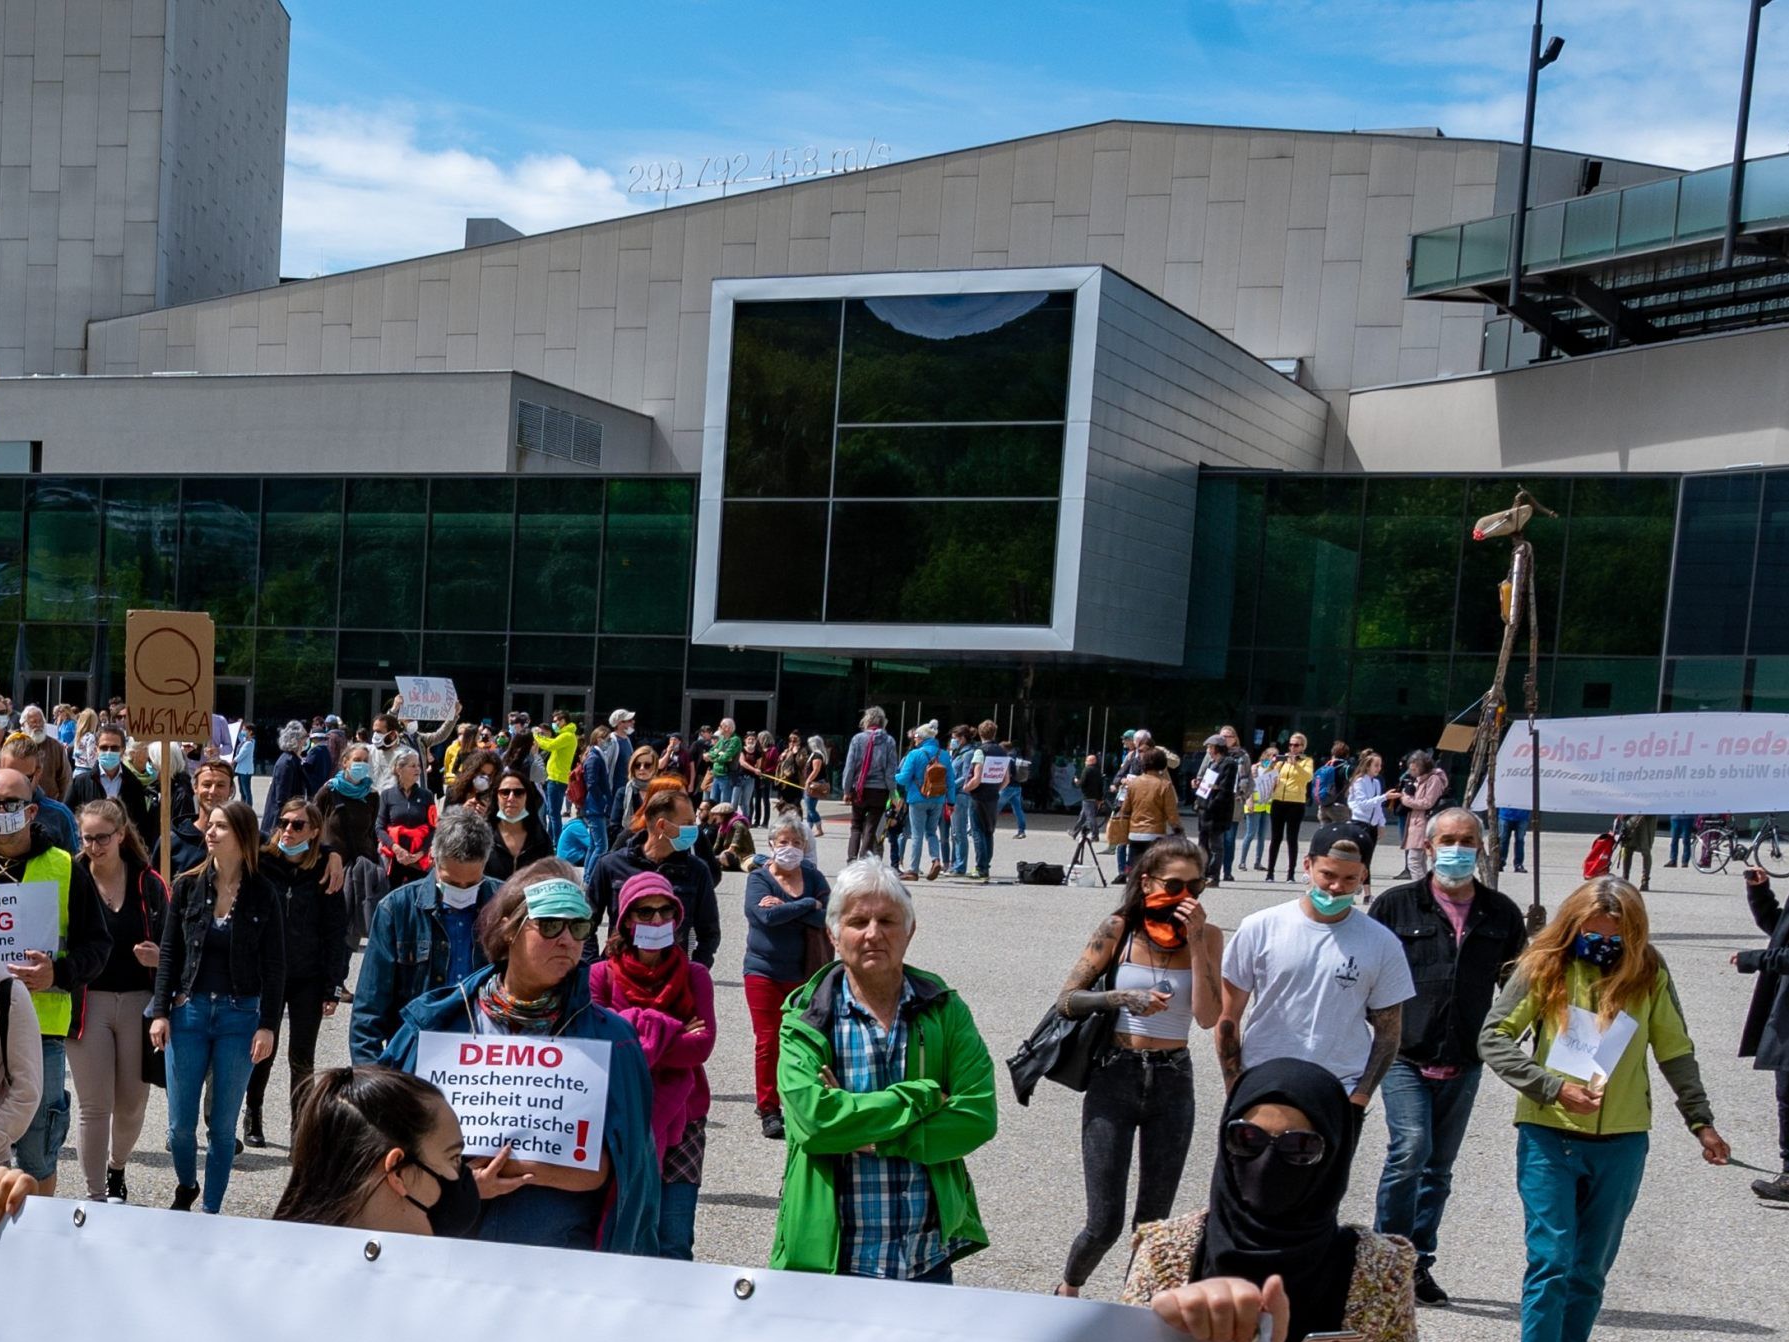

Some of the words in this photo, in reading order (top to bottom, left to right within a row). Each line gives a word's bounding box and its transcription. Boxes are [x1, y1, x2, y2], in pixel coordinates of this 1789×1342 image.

[628, 161, 683, 193] 299
[697, 152, 750, 187] 792
[762, 145, 818, 180] 458
[134, 627, 201, 709] Q
[127, 705, 211, 737] WWG1WGA
[459, 1043, 563, 1068] DEMO
[429, 1070, 589, 1094] Menschenrechte,
[451, 1091, 521, 1107] Freiheit
[527, 1096, 563, 1111] und
[460, 1111, 575, 1135] mokratische
[463, 1132, 562, 1155] undrechte
